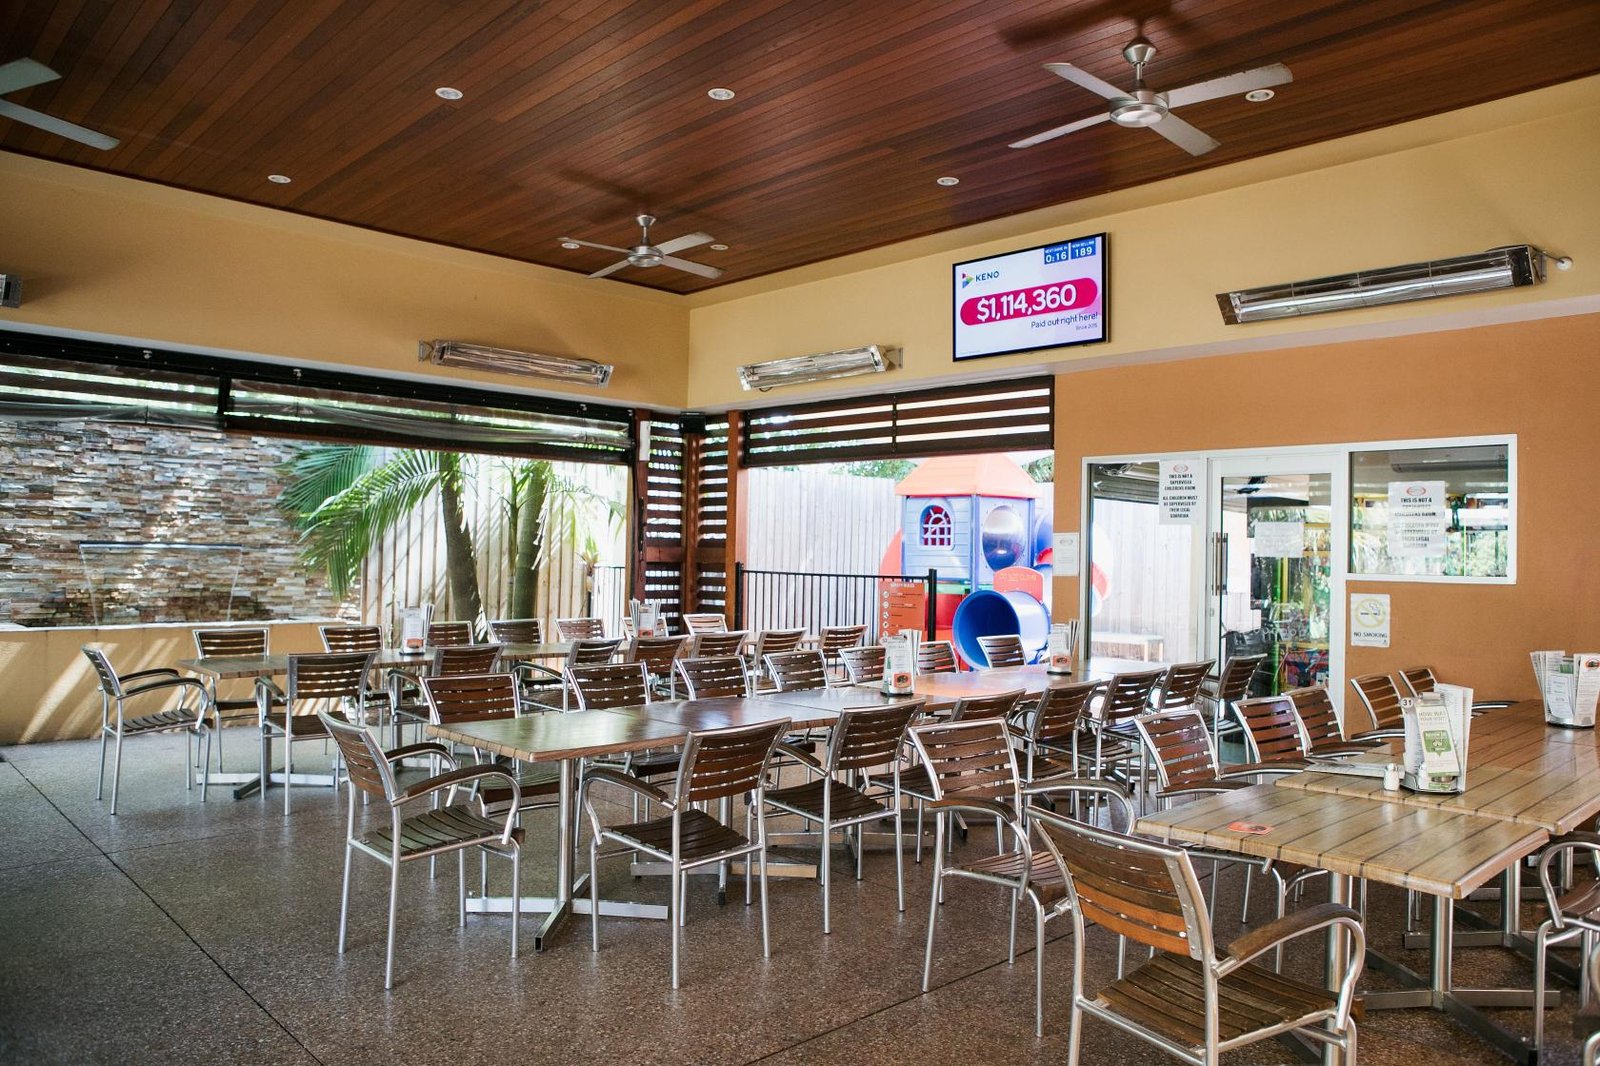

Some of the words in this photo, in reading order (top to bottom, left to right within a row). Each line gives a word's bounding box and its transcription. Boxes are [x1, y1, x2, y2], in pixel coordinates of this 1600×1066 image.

[1045, 252, 1067, 262] 0:16
[1076, 246, 1092, 257] 189
[975, 270, 1000, 282] KENO
[976, 284, 1077, 322] $1,114,360
[1031, 320, 1046, 328] Paid
[1047, 318, 1059, 326] out
[1060, 314, 1078, 325] right
[1078, 312, 1098, 322] here!
